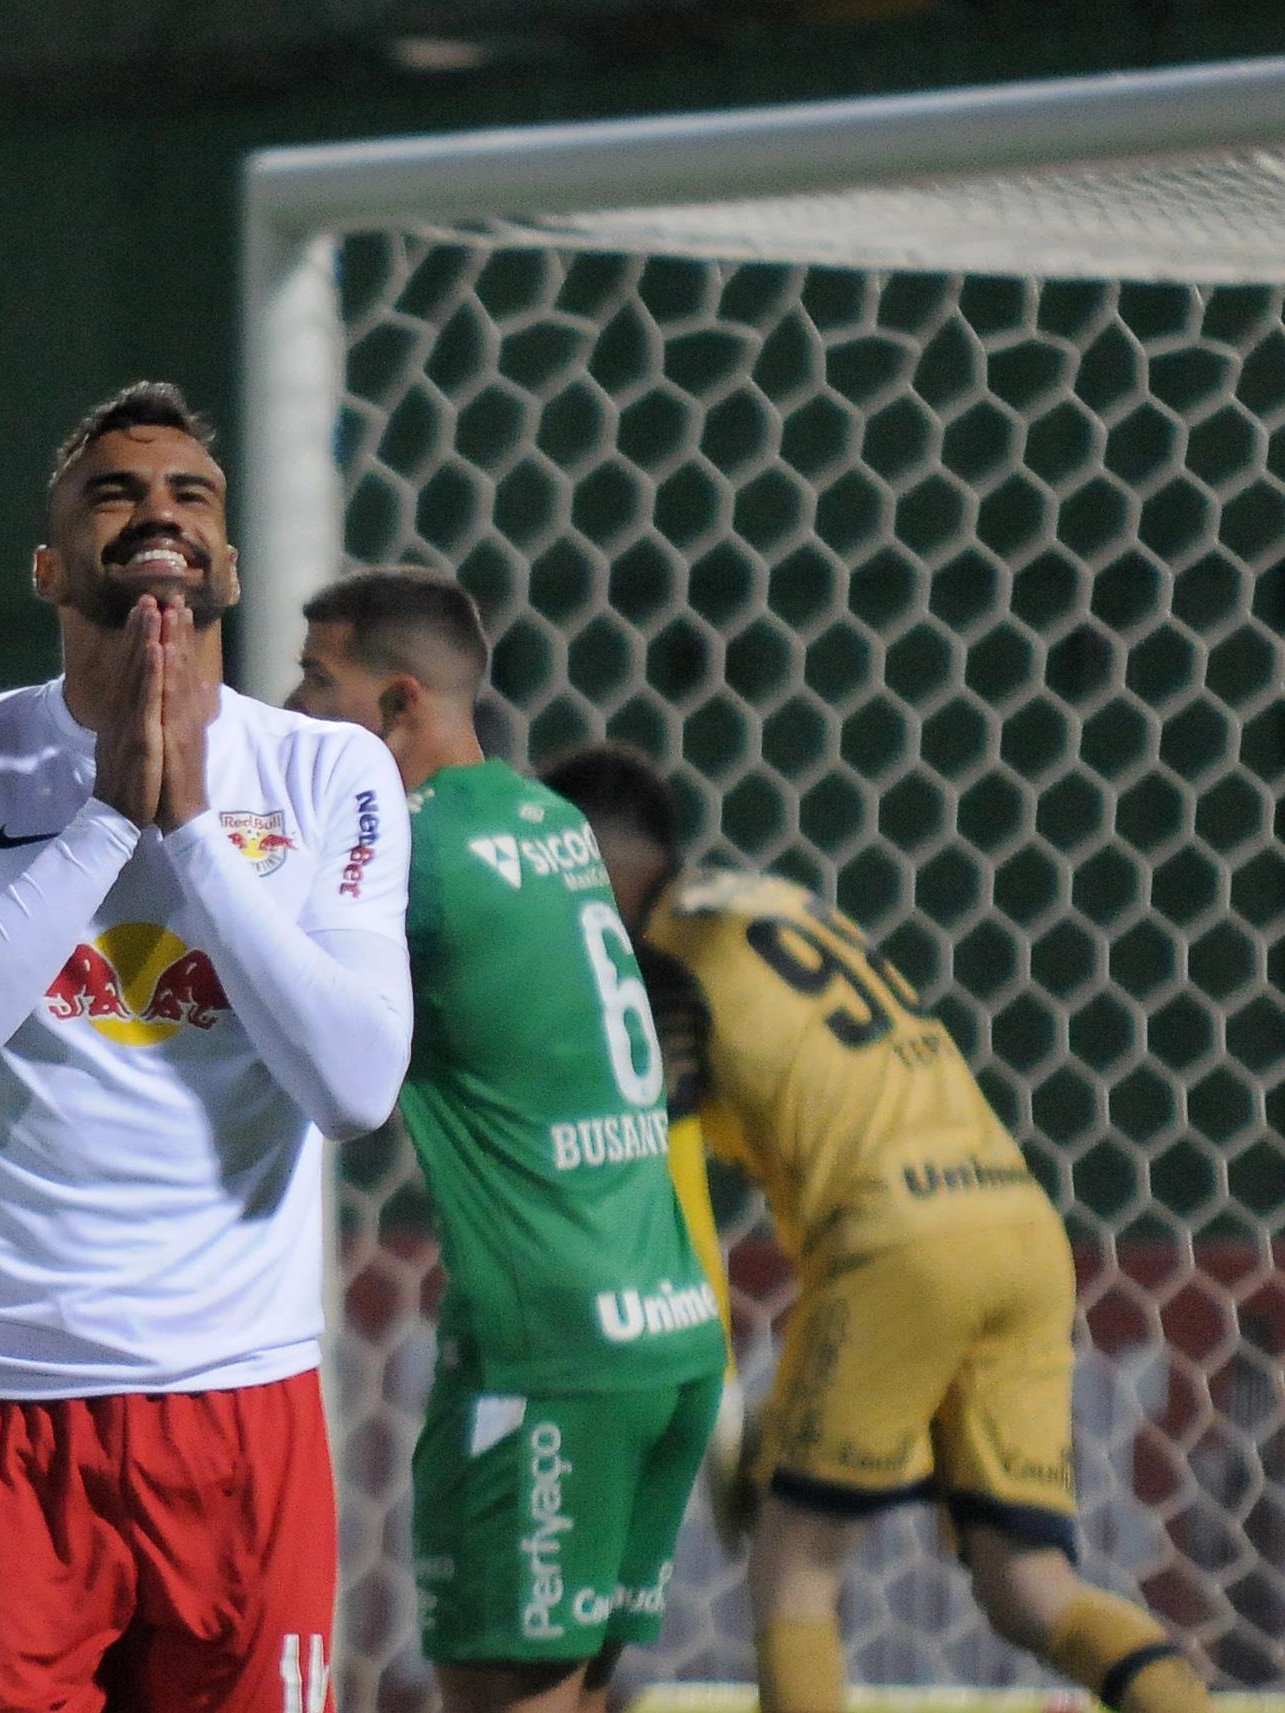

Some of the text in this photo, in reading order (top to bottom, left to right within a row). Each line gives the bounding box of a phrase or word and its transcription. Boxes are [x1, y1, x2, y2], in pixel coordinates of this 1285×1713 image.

[223, 815, 281, 830] Red Bull
[582, 901, 663, 1106] 6
